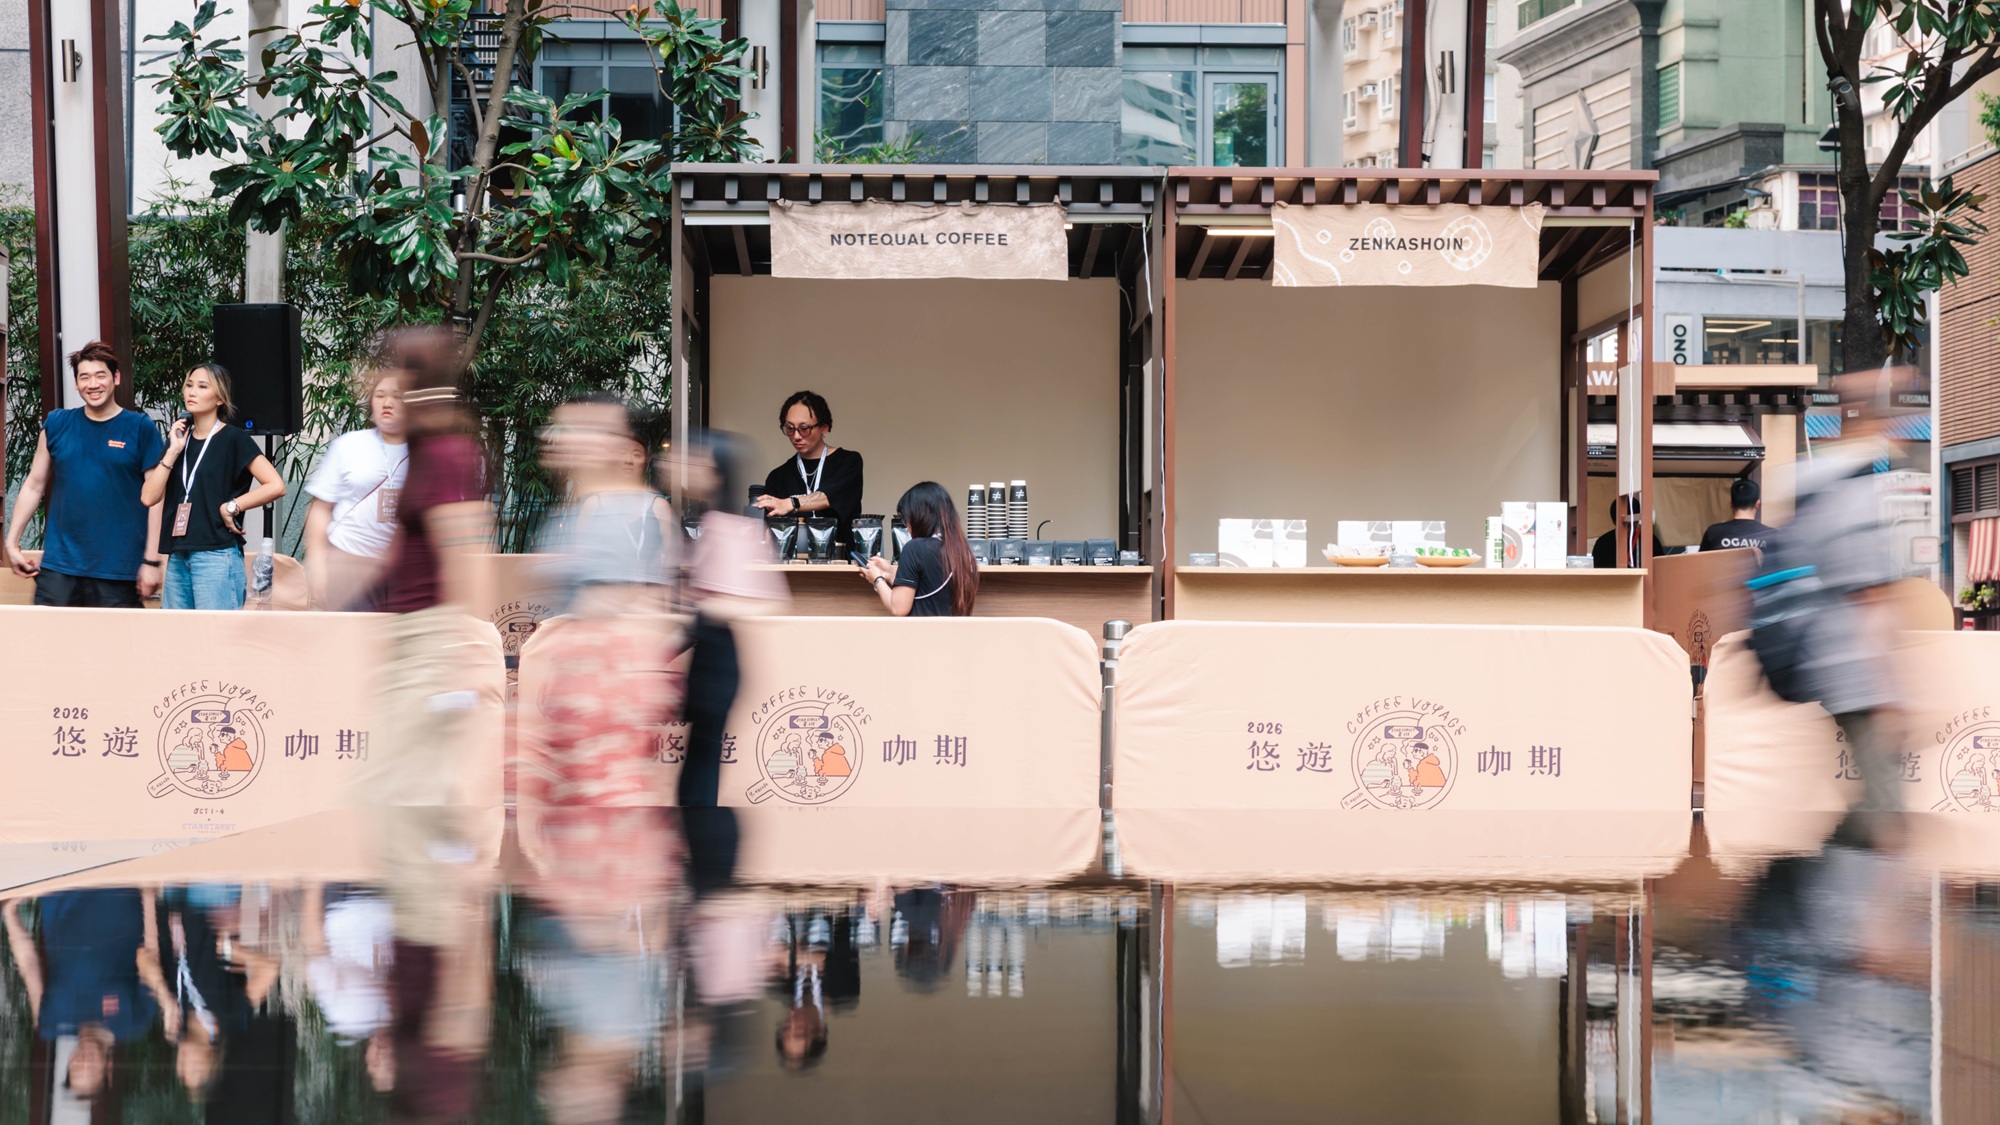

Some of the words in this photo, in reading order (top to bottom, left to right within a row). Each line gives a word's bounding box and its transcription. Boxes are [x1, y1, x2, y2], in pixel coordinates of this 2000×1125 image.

[830, 233, 929, 246] NOTEQUAL
[935, 232, 1008, 246] COFFEE
[1349, 237, 1463, 251] ZENKASHOIN
[1812, 393, 1840, 404] TANNING
[1898, 394, 1930, 404] PERSONAL
[1721, 537, 1767, 548] OGAWA
[489, 601, 521, 622] OFFEE
[153, 679, 209, 719] COFFEE
[218, 680, 275, 720] VOYAGE
[751, 685, 807, 725] COFFEE
[816, 686, 872, 725] VOYAGE
[53, 707, 88, 720] 2026
[1346, 695, 1402, 735] COFFEE
[1411, 697, 1467, 736] VOYAGE
[1247, 722, 1282, 735] 2026
[1935, 705, 1991, 745] COFFEE
[52, 726, 139, 758] 悠遊
[285, 729, 370, 762] 咖期
[882, 734, 968, 768] 咖期
[1246, 740, 1334, 774] 悠遊
[1477, 745, 1562, 777] 咖期
